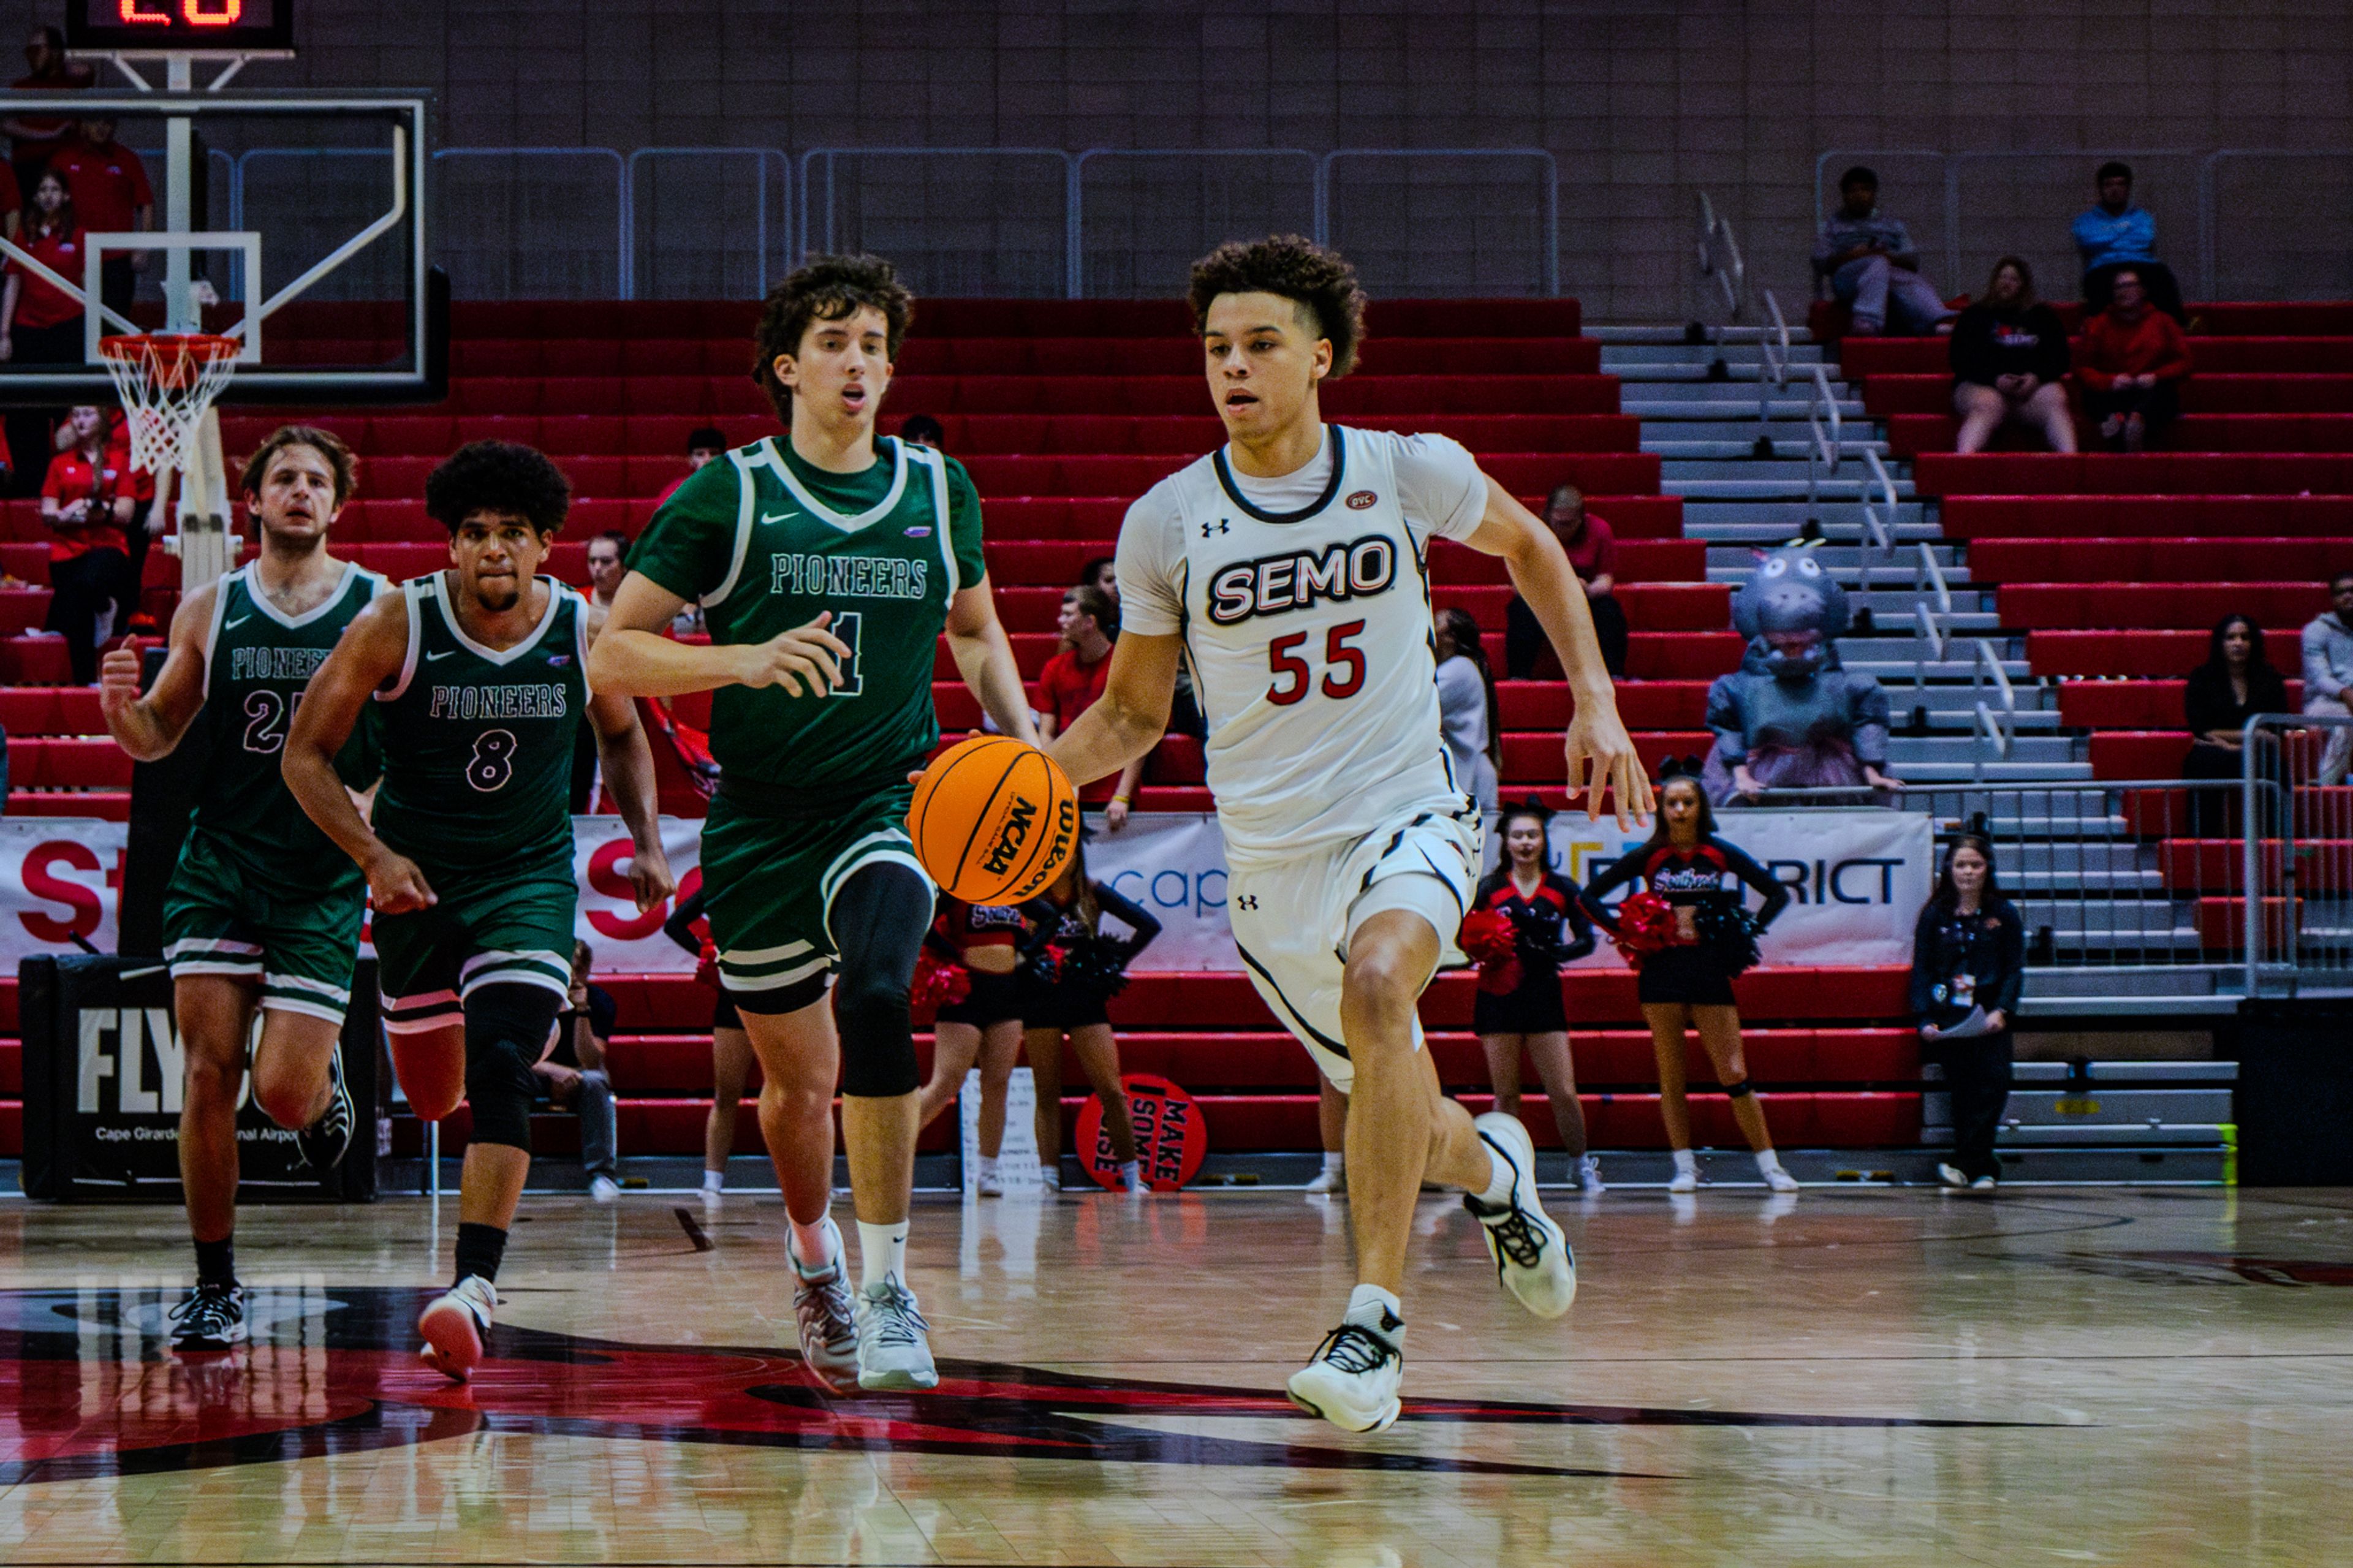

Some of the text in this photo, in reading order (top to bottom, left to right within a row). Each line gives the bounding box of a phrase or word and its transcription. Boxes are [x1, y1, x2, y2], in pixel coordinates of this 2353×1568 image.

[770, 553, 928, 599] PIONEERS
[1211, 537, 1395, 624] SEMO
[232, 647, 335, 680] PIONEE
[829, 612, 863, 696] 1
[1266, 618, 1367, 706] 55
[430, 683, 567, 719] PIONEERS
[466, 729, 517, 792] 8
[983, 795, 1038, 875] NCAA
[1013, 798, 1074, 897] Wilson
[77, 1008, 186, 1113] FLY
[96, 1127, 131, 1143] Cape
[1155, 1099, 1189, 1183] MAKE
